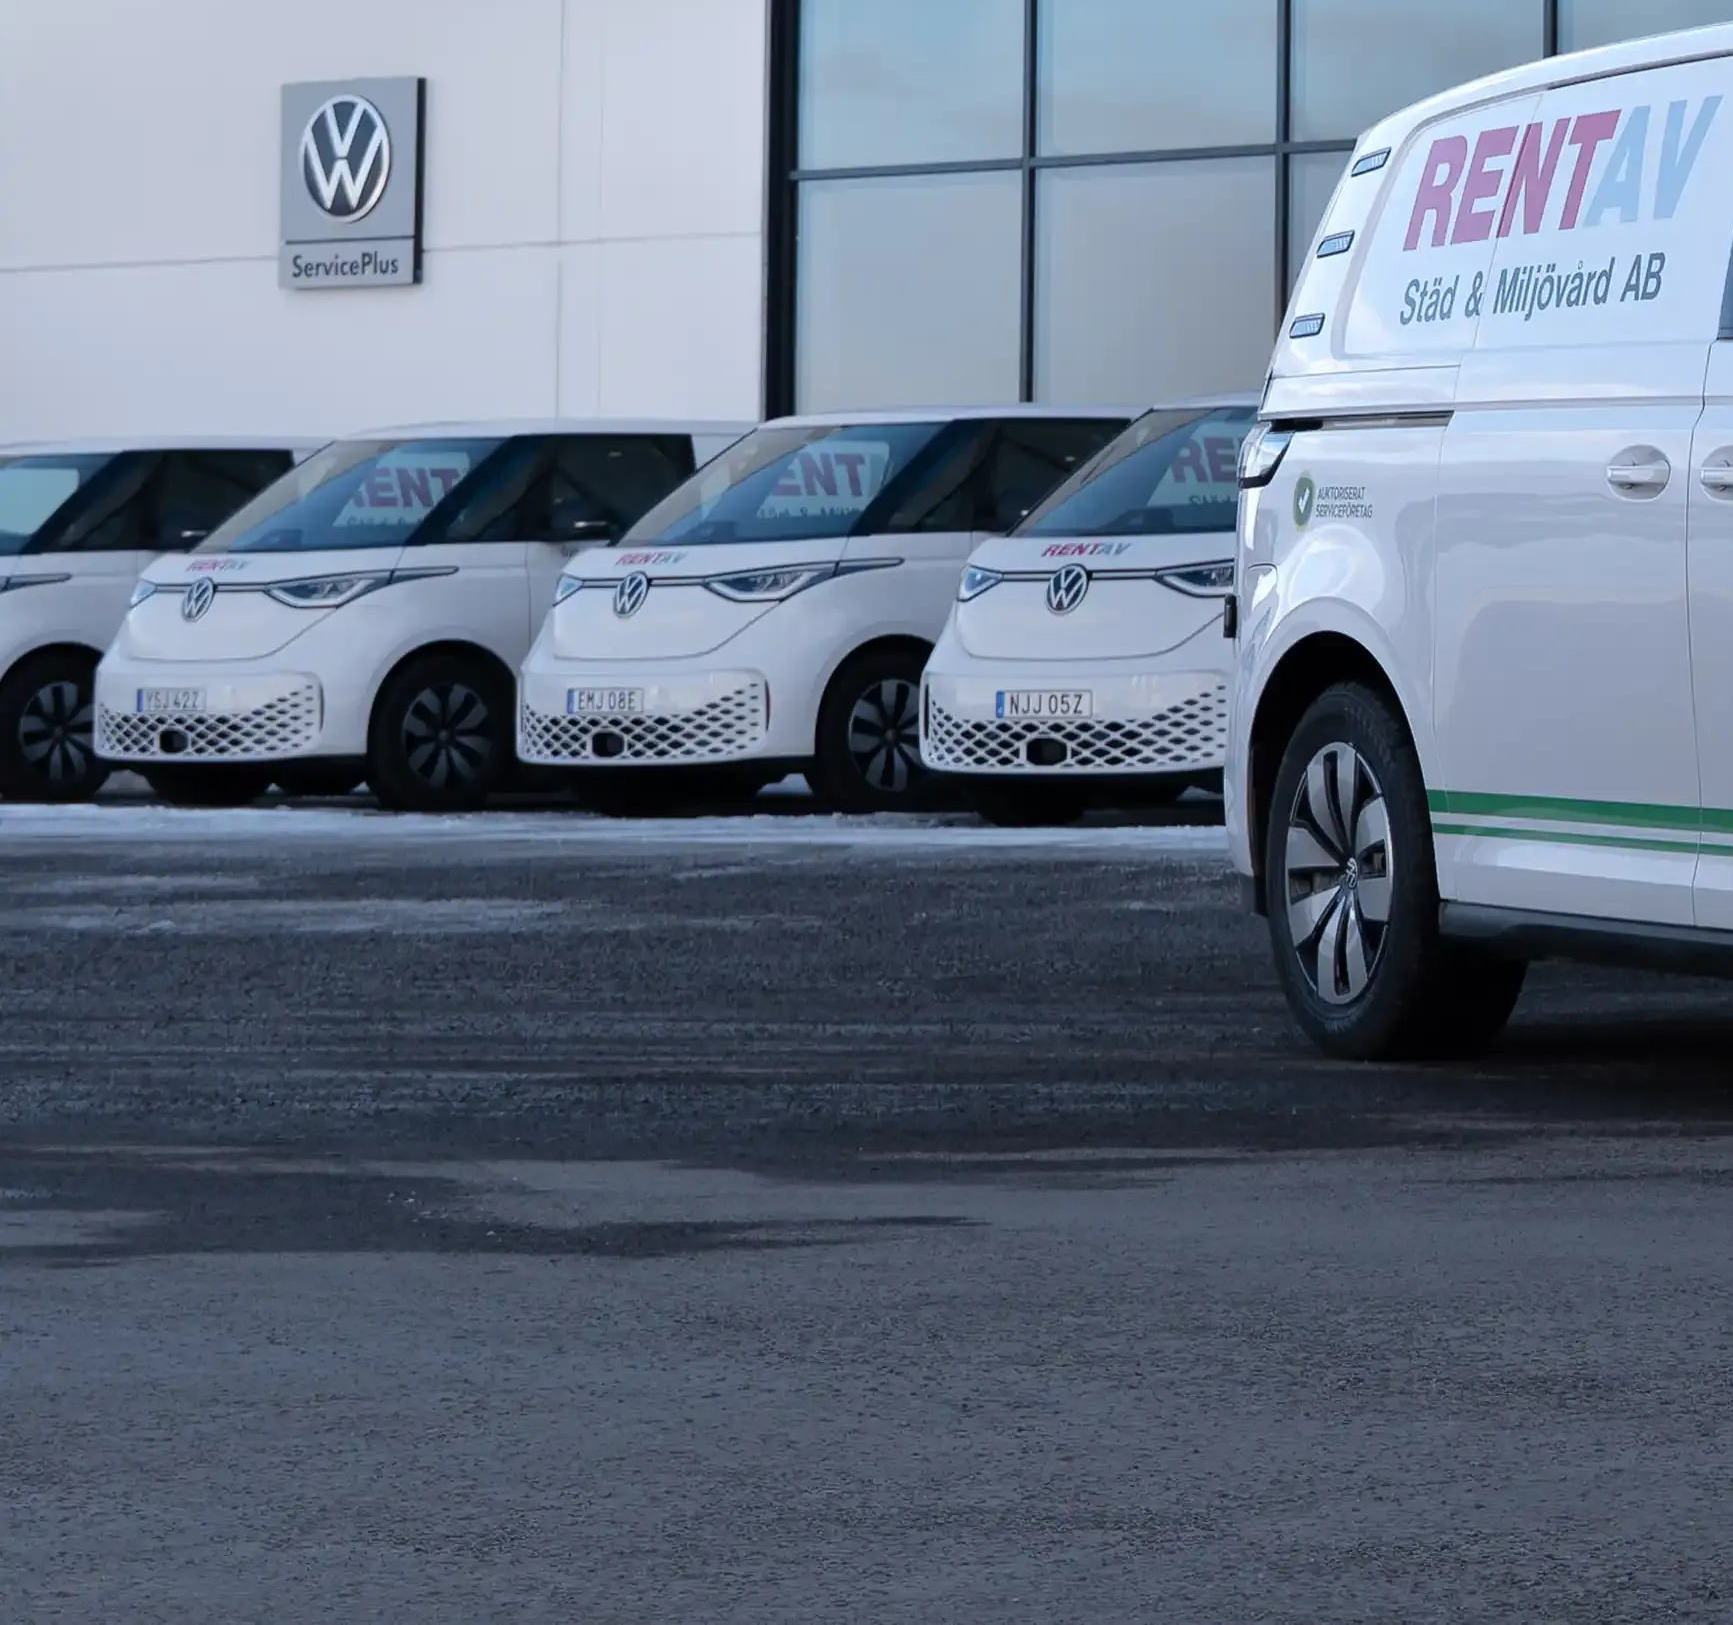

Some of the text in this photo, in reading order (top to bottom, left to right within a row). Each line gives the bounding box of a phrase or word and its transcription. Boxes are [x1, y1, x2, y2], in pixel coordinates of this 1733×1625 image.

[1403, 95, 1723, 251] RENTAV
[292, 250, 399, 278] ServicePlus
[1400, 252, 1666, 325] Städ & Miljövård AB
[1317, 486, 1366, 500] AUKTORISERAT
[615, 551, 688, 566] RENTAV
[1041, 543, 1132, 557] RENTAV
[577, 691, 604, 711] EMJ
[1010, 694, 1084, 716] NJJ 05Z
